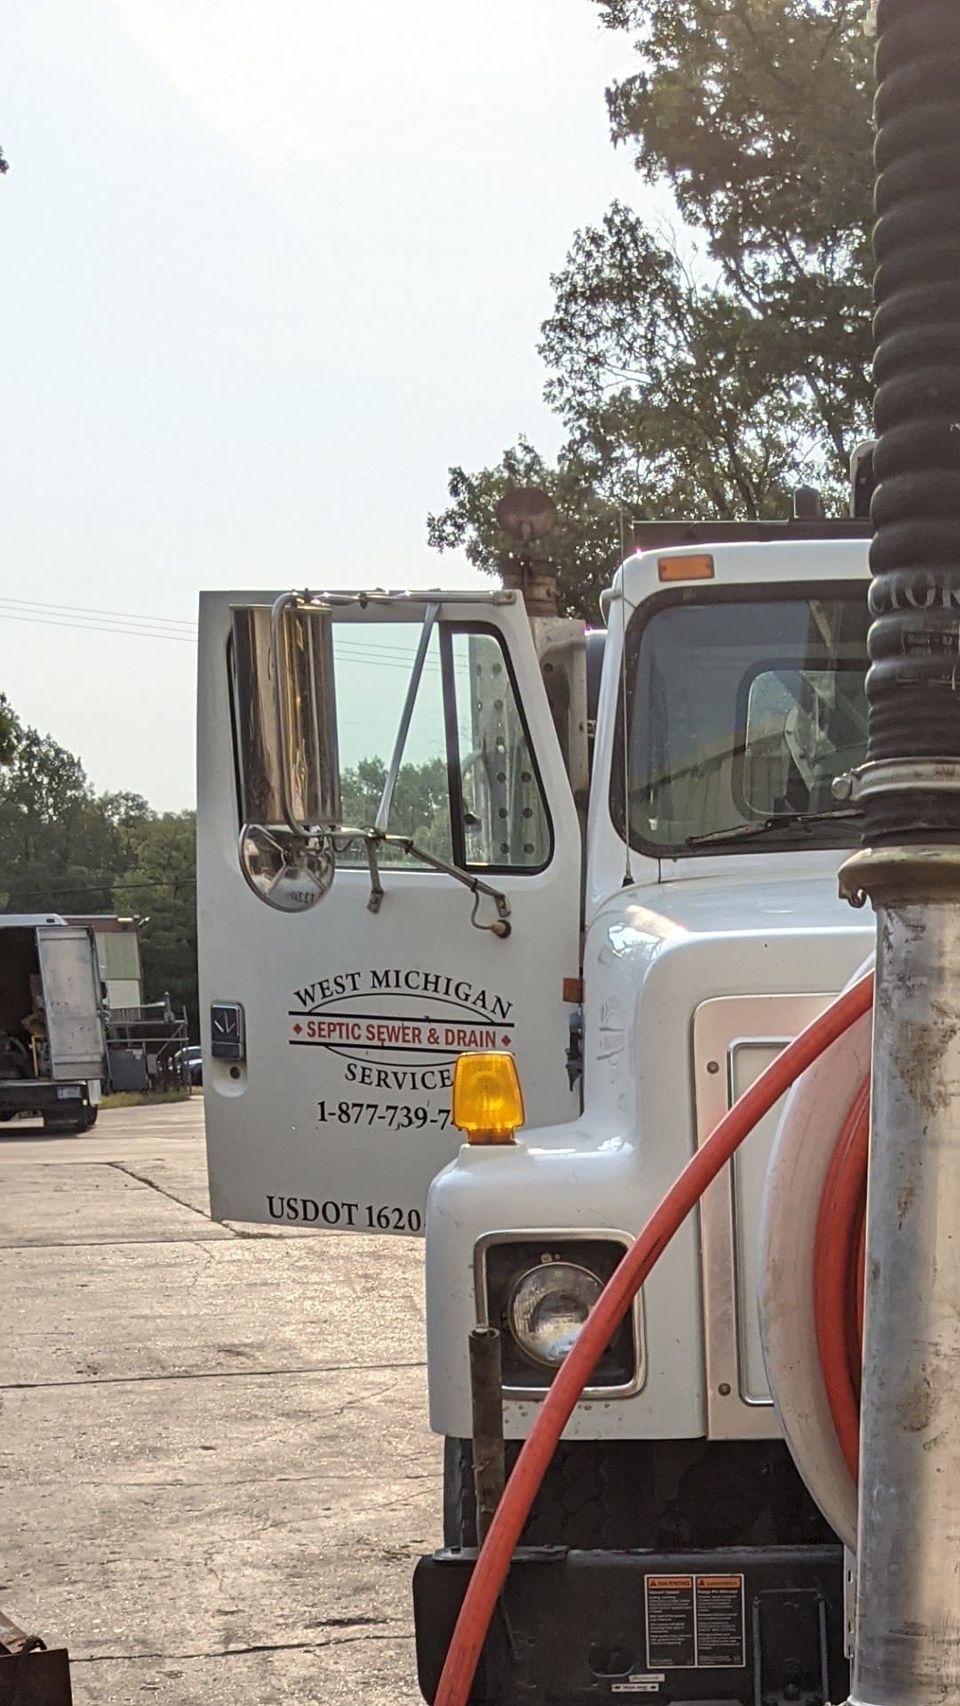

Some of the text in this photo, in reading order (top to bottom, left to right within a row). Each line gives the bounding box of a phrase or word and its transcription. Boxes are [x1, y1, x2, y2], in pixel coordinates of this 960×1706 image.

[293, 969, 514, 1020] WEST MICHIGAN
[306, 1020, 496, 1049] SEPTIC SEWER & DRAIN
[344, 1063, 454, 1090] SERVICE
[317, 1101, 454, 1131] 1-877-739-7
[266, 1195, 427, 1232] USDOT 1620
